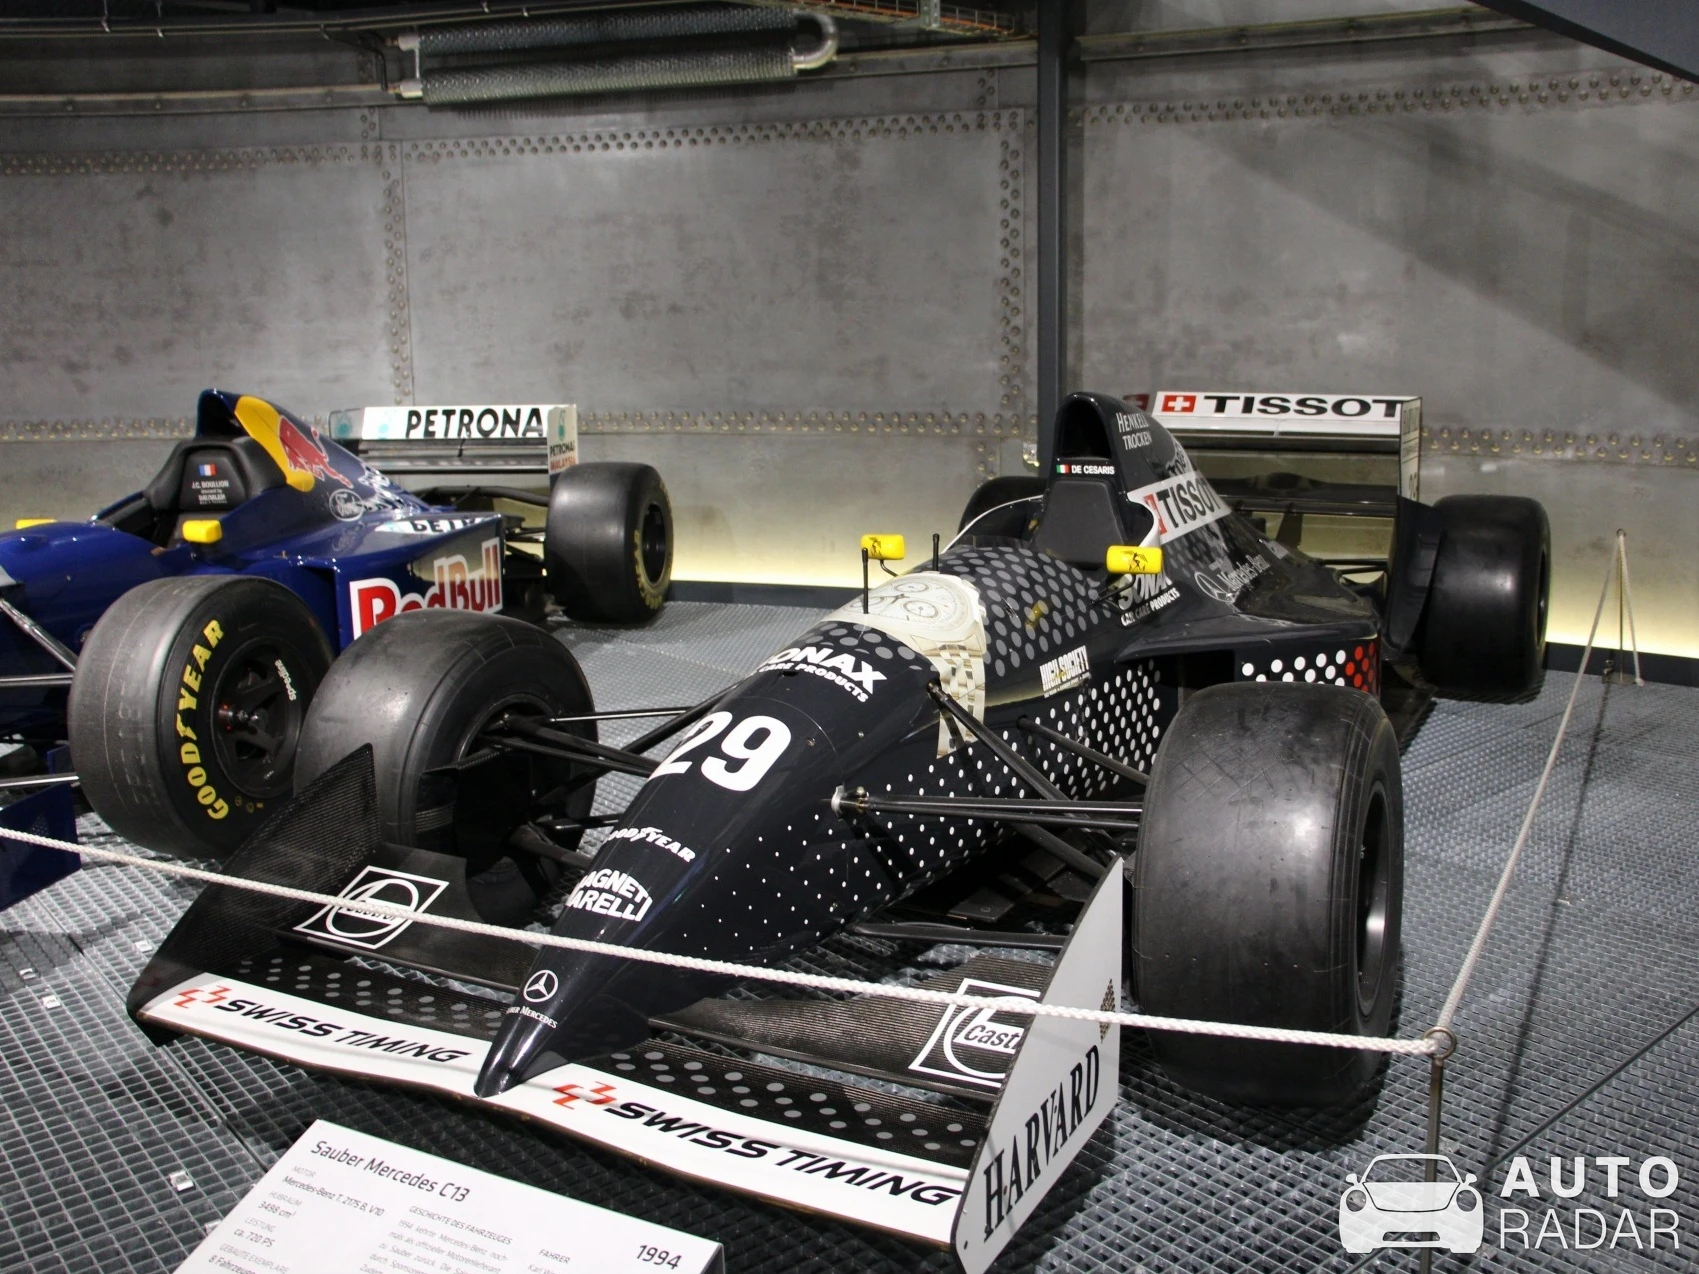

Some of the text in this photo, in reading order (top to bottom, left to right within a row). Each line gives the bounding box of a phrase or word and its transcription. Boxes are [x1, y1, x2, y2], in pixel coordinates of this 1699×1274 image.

[1204, 395, 1403, 418] TISSOT
[405, 408, 544, 438] PETRONA
[1115, 412, 1149, 433] HENKELL
[1071, 464, 1115, 475] DE CESARIS
[1156, 477, 1222, 529] TISSOT
[1150, 587, 1180, 612] PRODUCTS
[764, 646, 888, 695] ONAX
[795, 663, 869, 703] PRODUCTS
[648, 711, 792, 792] 29
[605, 826, 696, 862] OODYEAR
[213, 999, 473, 1063] SWISS TIMING
[520, 1006, 558, 1029] MERCEDES
[964, 1024, 1021, 1050] Cast
[602, 1102, 964, 1206] SWISS TIMING
[983, 1045, 1100, 1243] HARVARD
[311, 1140, 471, 1202] Sauber Mercedes C13
[282, 1175, 336, 1200] Mercedes-Benz
[246, 1230, 263, 1245] 720
[262, 1235, 276, 1248] PS
[409, 1205, 513, 1245] GESCHICHTE DES FAHRZEUGES
[538, 1248, 571, 1264] FAHRER
[636, 1244, 682, 1270] 1994
